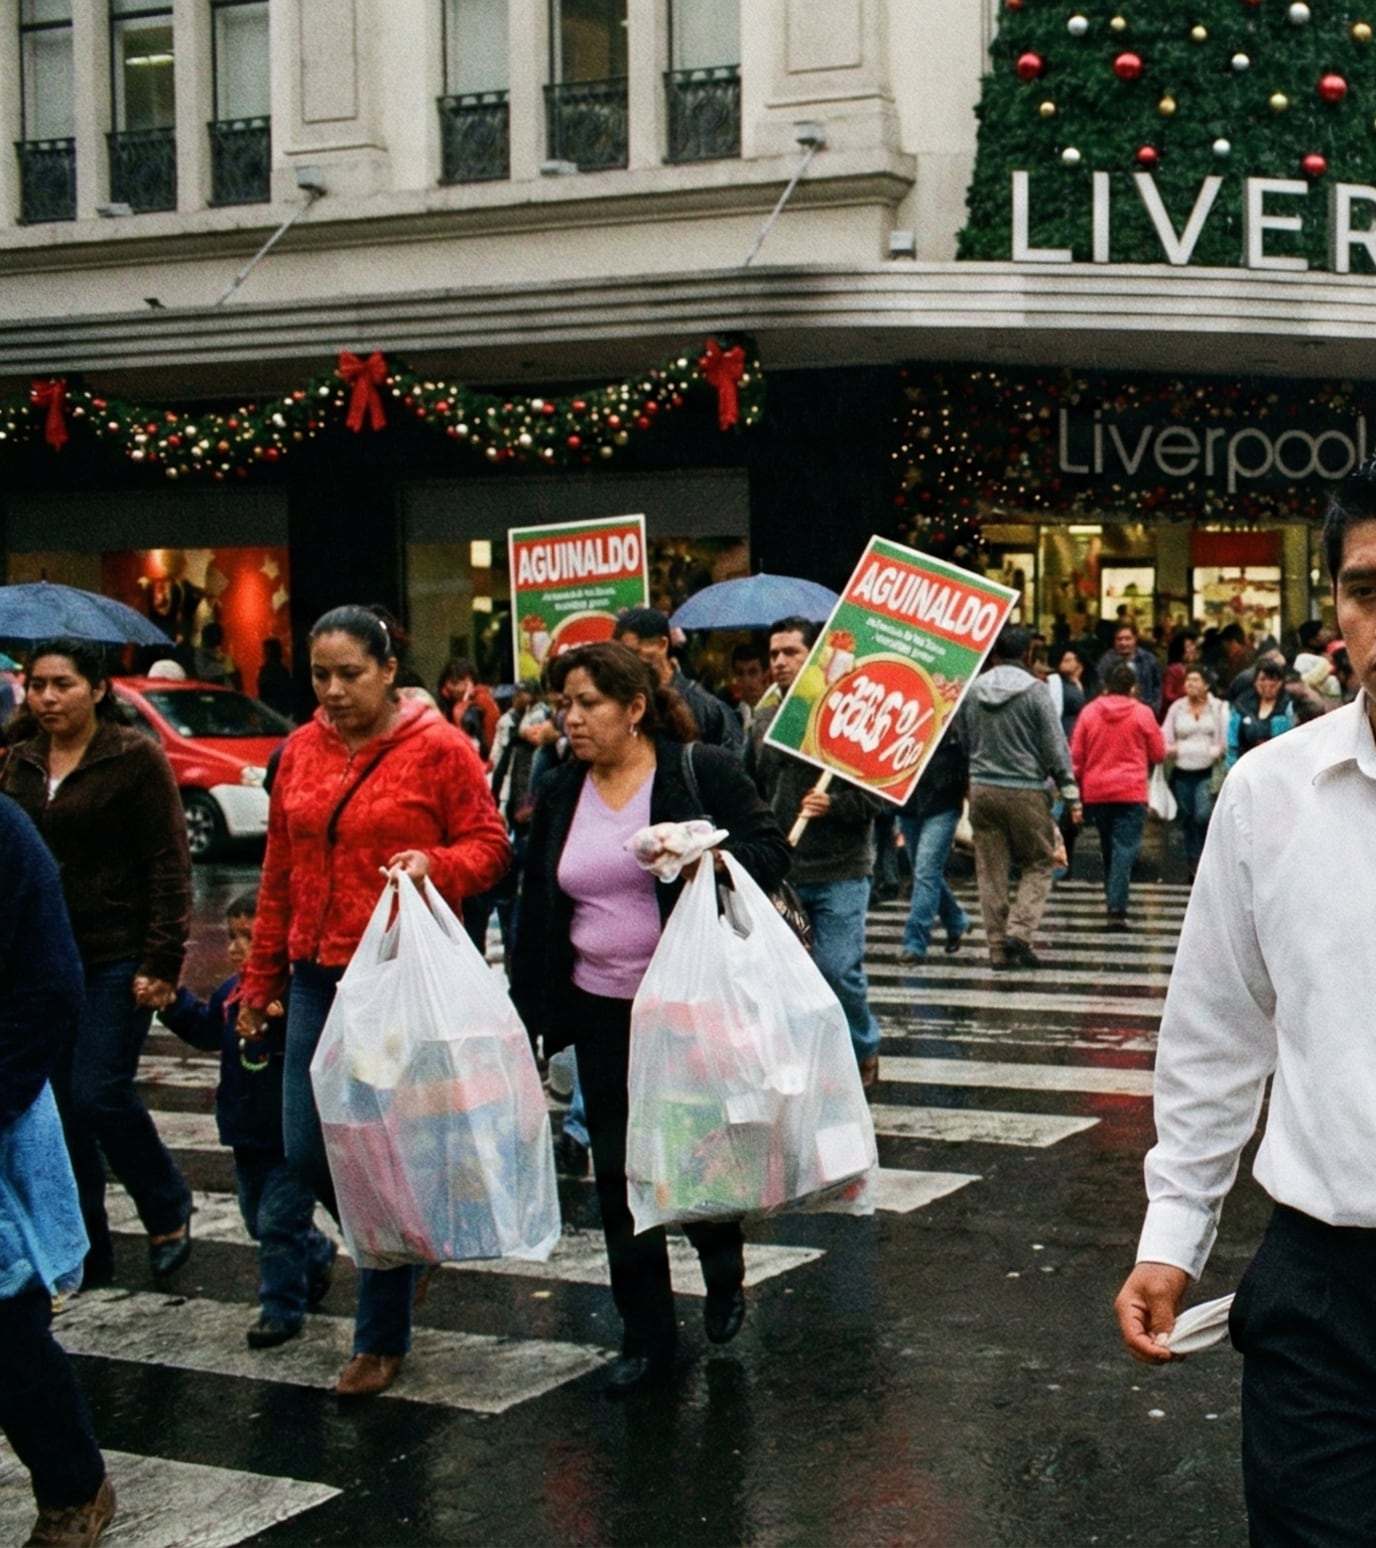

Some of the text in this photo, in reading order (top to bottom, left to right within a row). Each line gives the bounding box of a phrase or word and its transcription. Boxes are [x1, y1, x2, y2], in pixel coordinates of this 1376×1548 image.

[1058, 408, 1367, 494] Liverpool
[517, 533, 640, 586] AGUINALDO
[852, 561, 998, 642] AGUINALDO
